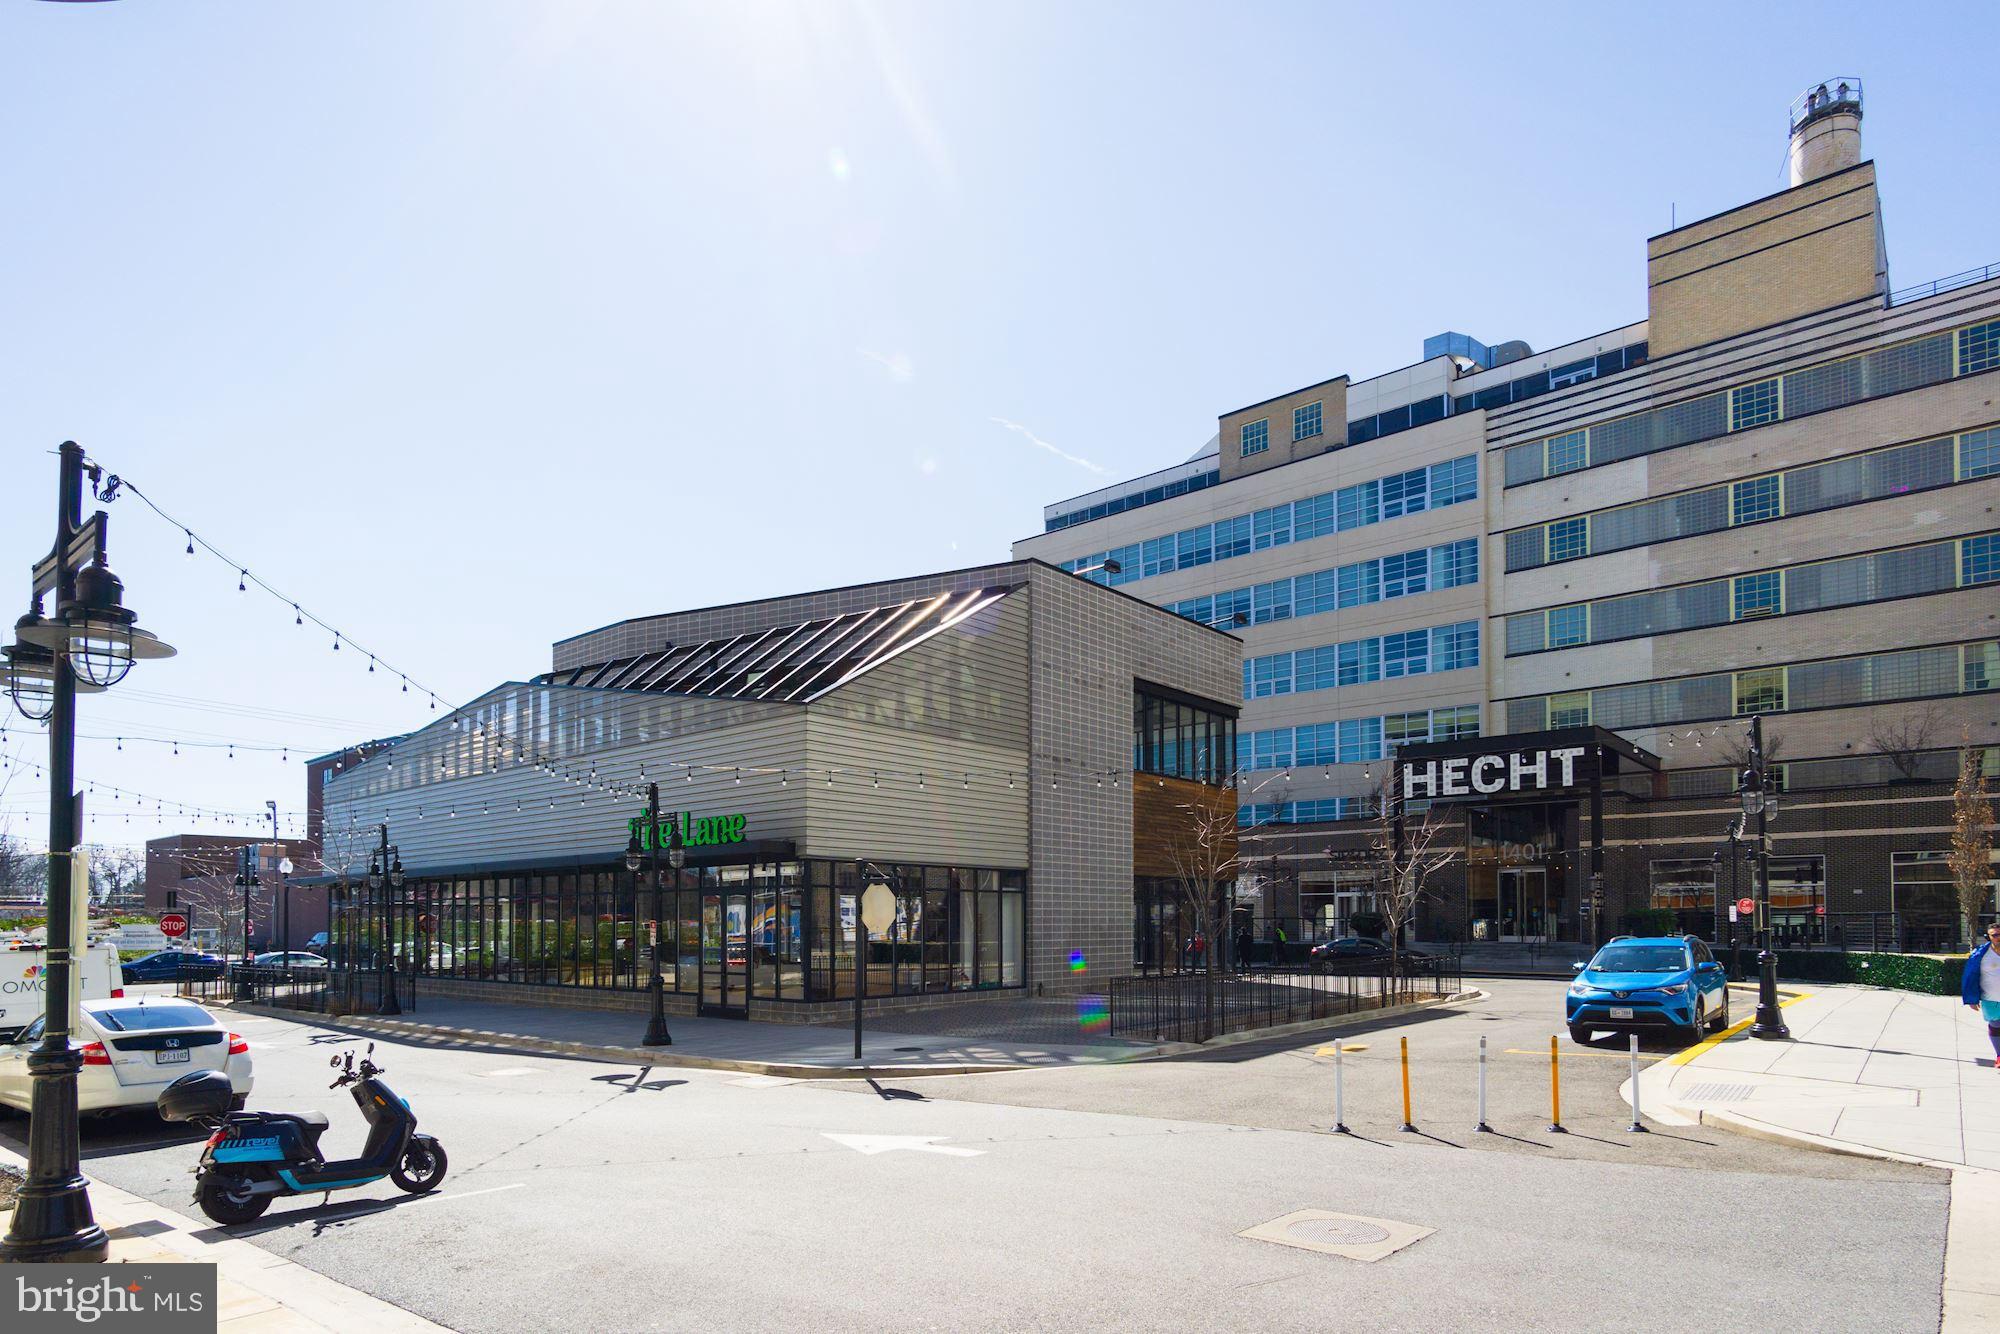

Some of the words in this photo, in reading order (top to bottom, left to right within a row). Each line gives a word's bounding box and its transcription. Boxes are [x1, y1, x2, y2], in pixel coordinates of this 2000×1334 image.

[1403, 747, 1585, 799] HECHT
[681, 811, 747, 847] Lane
[1501, 842, 1543, 860] 1401
[161, 921, 187, 931] STOP
